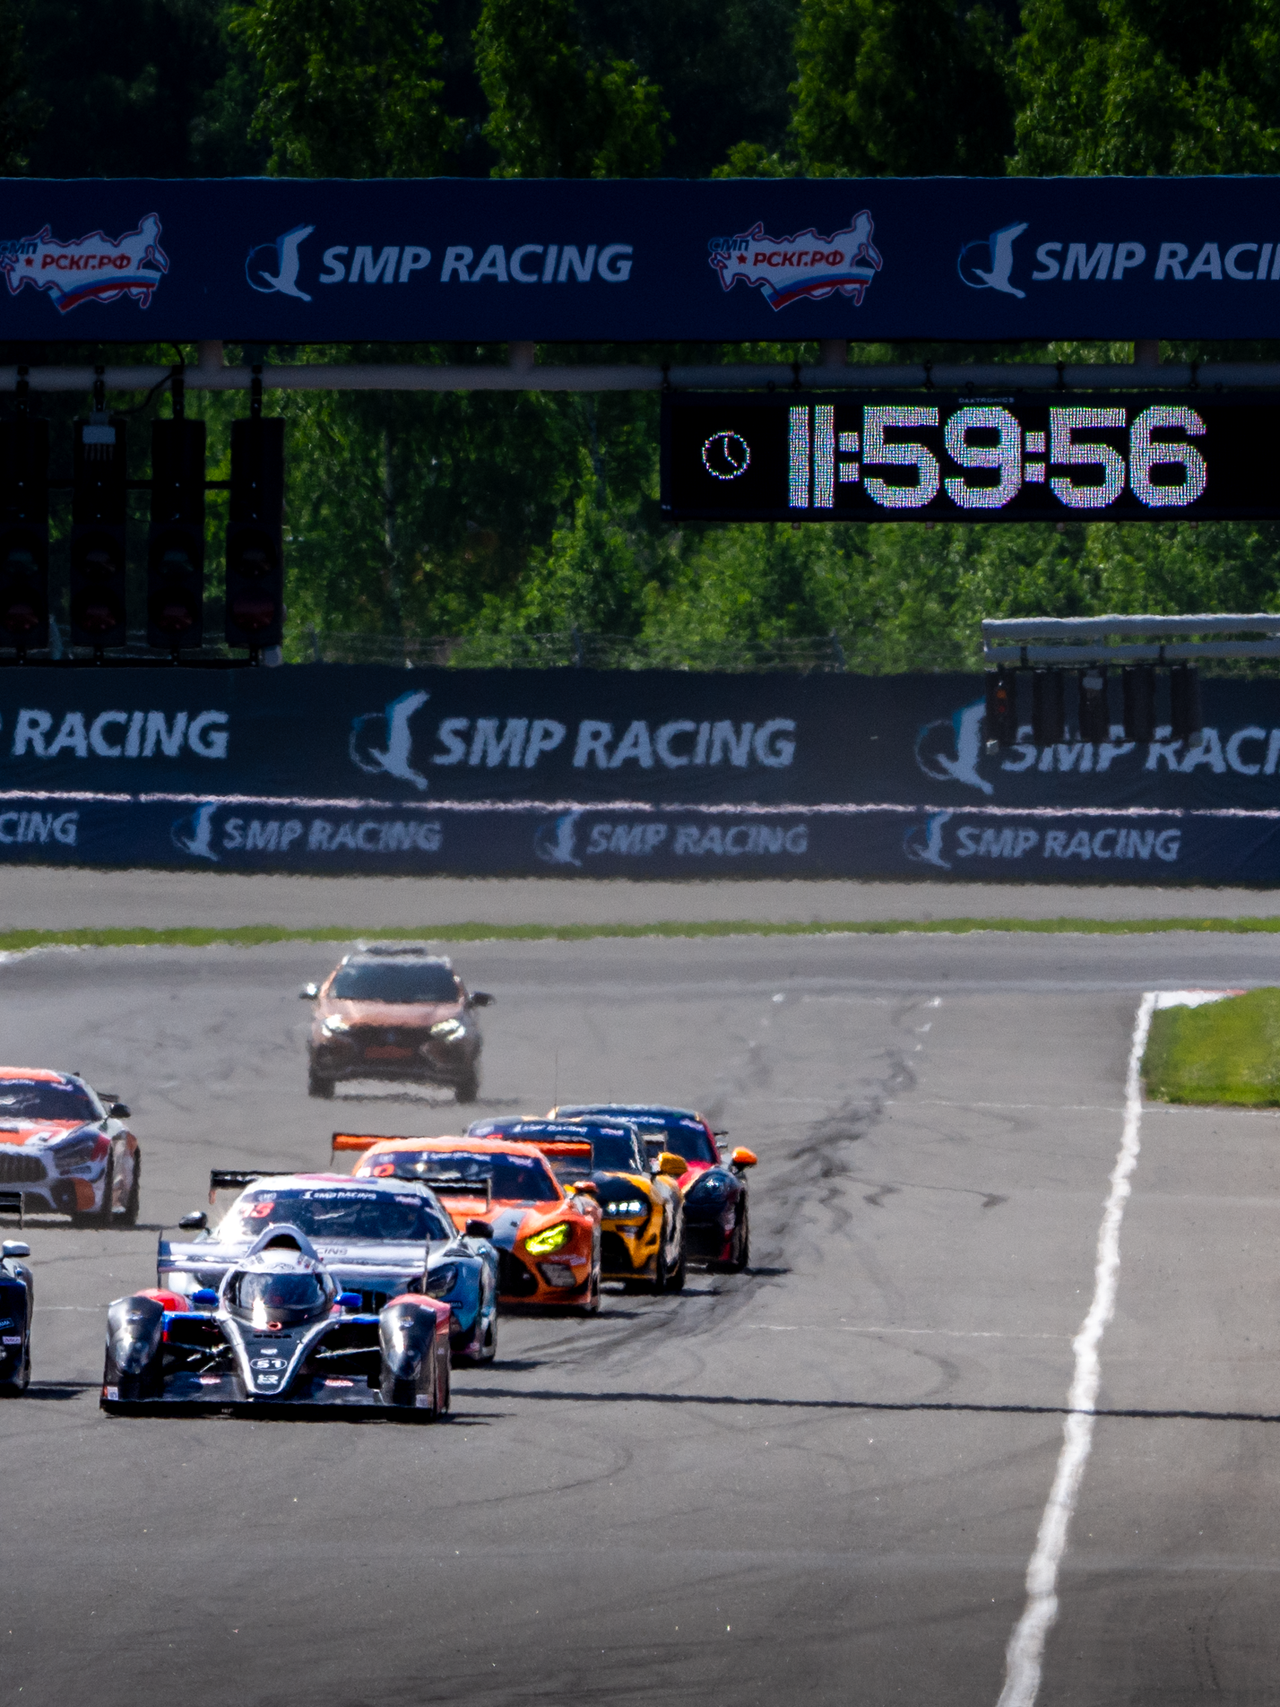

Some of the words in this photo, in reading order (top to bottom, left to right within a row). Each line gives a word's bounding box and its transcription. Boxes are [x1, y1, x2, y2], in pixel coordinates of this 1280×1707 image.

[41, 253, 132, 270] РСКГ.РФ
[319, 245, 431, 283] SMP
[440, 245, 633, 283] RACING
[753, 250, 845, 267] РСКГ.РФ
[1032, 242, 1146, 280] SMP
[1154, 242, 1280, 280] RACI
[789, 406, 1207, 509] 11:59:56
[12, 709, 229, 759] RACING
[433, 717, 567, 768] SMP
[572, 718, 797, 768] RACING
[223, 817, 304, 852] SMP
[308, 819, 442, 852] RACING
[586, 823, 668, 855] SMP
[673, 823, 808, 856] RACING
[956, 825, 1040, 858] SMP
[1043, 827, 1182, 862] RACING
[256, 1359, 282, 1369] 51
